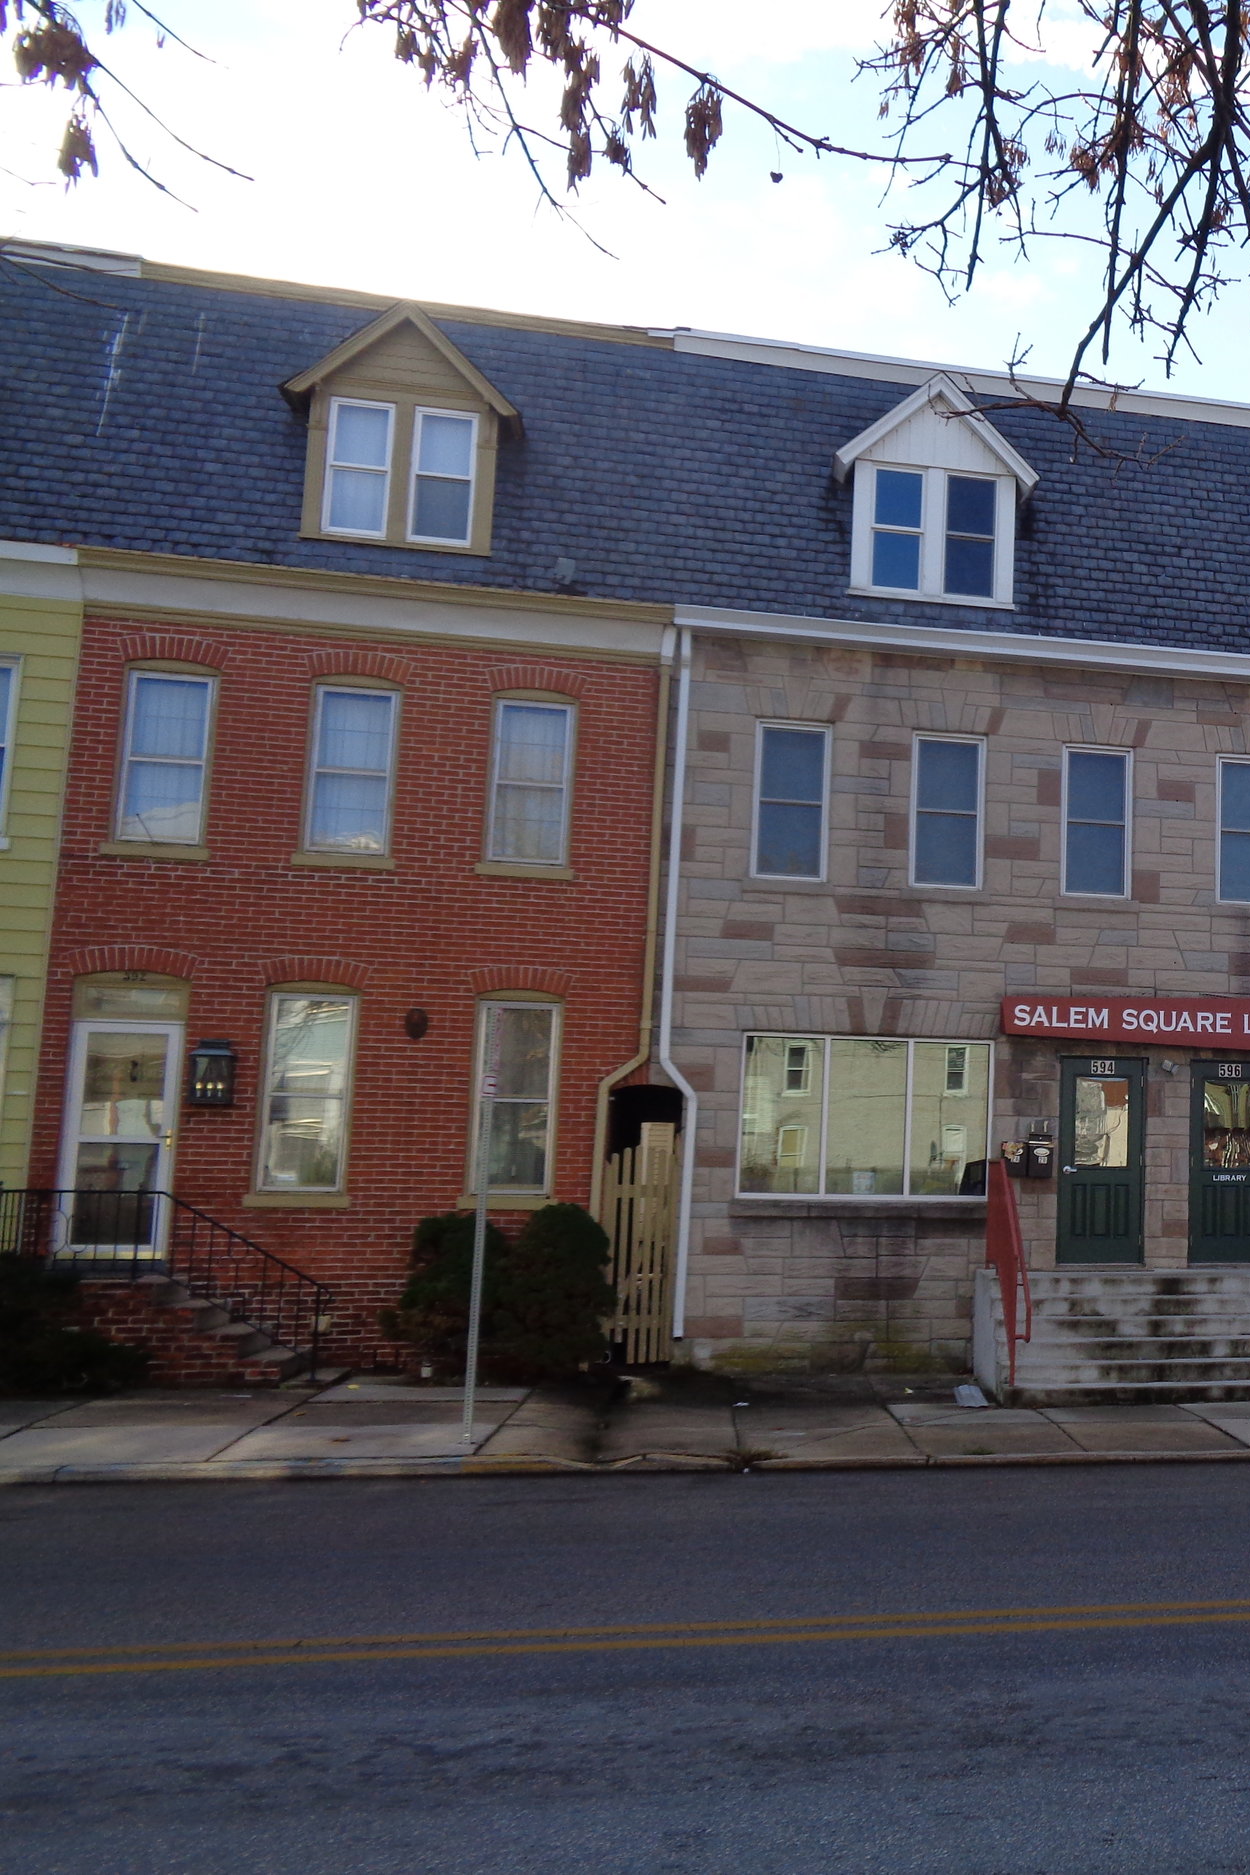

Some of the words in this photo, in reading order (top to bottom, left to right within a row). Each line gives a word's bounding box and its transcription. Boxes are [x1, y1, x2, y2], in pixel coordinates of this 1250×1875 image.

[1013, 1004, 1109, 1030] SALEM
[1121, 1008, 1232, 1034] SQUARE
[1092, 1061, 1114, 1074] 594
[1220, 1064, 1241, 1077] 596
[1212, 1174, 1247, 1182] LIBRARY
